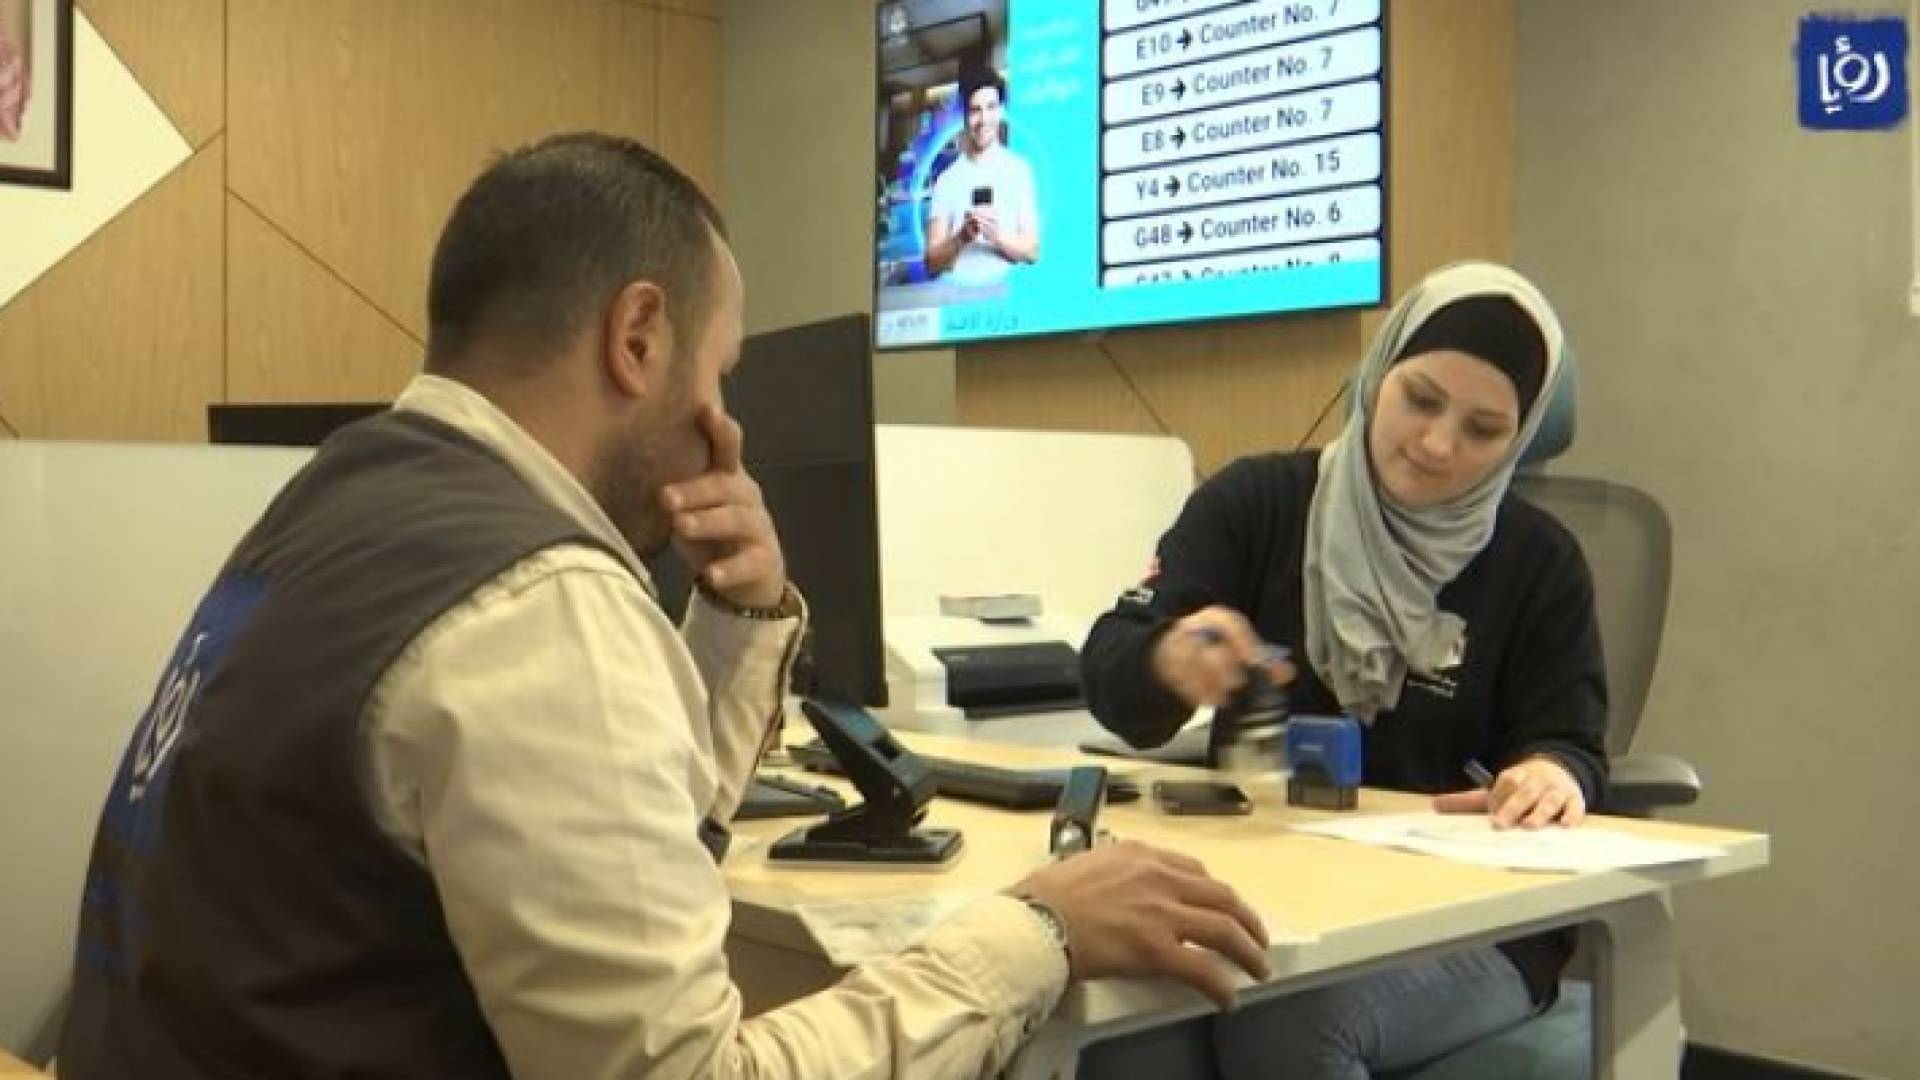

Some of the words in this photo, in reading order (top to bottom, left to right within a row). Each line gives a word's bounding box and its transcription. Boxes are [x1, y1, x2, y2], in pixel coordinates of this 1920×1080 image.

[1136, 32, 1172, 60] E10
[1199, 12, 1277, 44] Counter
[1284, 4, 1317, 26] No.
[1141, 82, 1165, 106] E9
[1192, 63, 1271, 95] Counter
[1276, 55, 1313, 78] No.
[1320, 46, 1333, 70] 7
[1141, 129, 1164, 152] E8
[1192, 113, 1271, 145] Counter
[1276, 106, 1313, 129] No.
[1320, 97, 1333, 121] 7
[1136, 178, 1159, 200] Y4
[1187, 165, 1265, 193] Counter
[1271, 158, 1307, 180] No.
[1315, 149, 1341, 173] 15
[1134, 222, 1173, 248] G48
[1200, 213, 1280, 241] Counter
[1285, 206, 1321, 229] No.
[1328, 200, 1341, 223] 6
